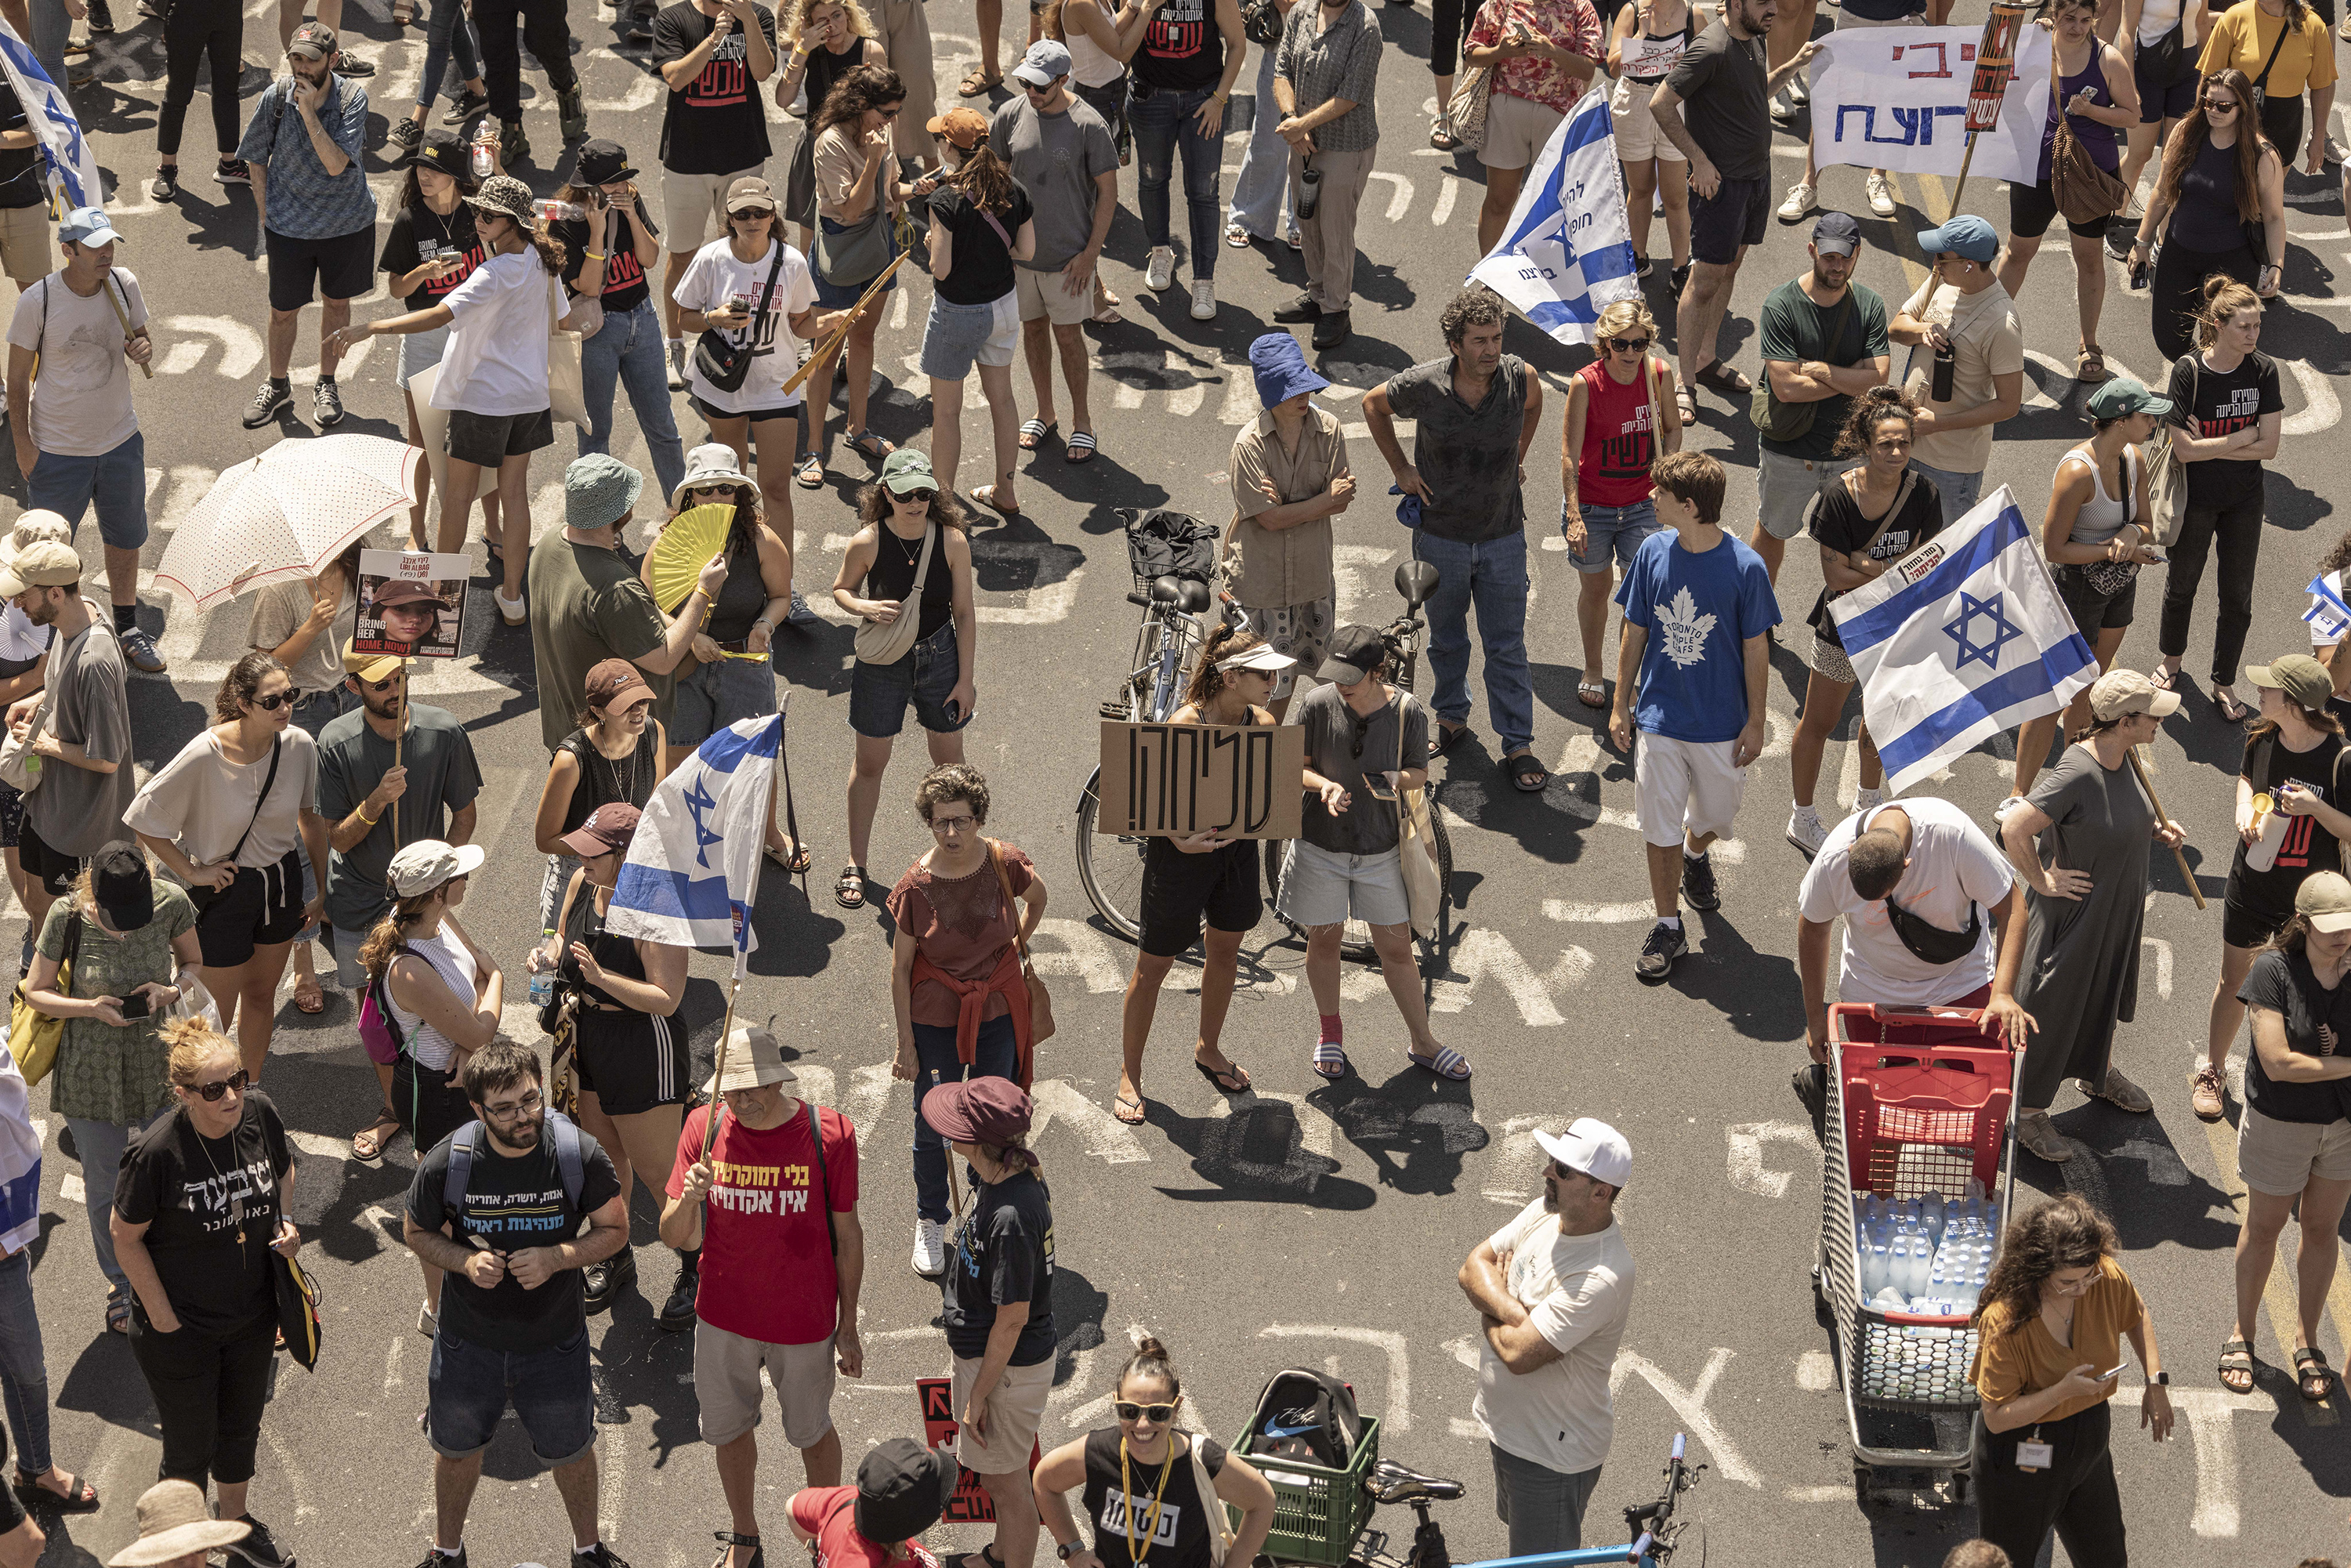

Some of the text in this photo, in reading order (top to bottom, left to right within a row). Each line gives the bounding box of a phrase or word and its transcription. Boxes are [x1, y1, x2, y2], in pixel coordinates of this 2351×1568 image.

[418, 238, 437, 252] BRING
[2231, 388, 2259, 404] מחזירים
[2216, 403, 2241, 418] הביתה
[1621, 419, 1646, 435] הביתה
[1903, 556, 1923, 571] נחזור
[1909, 553, 1940, 581] הביתה?
[358, 618, 386, 630] BRING
[357, 629, 375, 639] HER
[356, 639, 411, 654] HOME NOW!
[1128, 726, 1273, 834] סליחה!
[784, 1164, 810, 1186] בלי
[465, 1193, 501, 1204] אחריות
[779, 1190, 808, 1216] אין
[462, 1214, 564, 1233] מנהיגות ראויה
